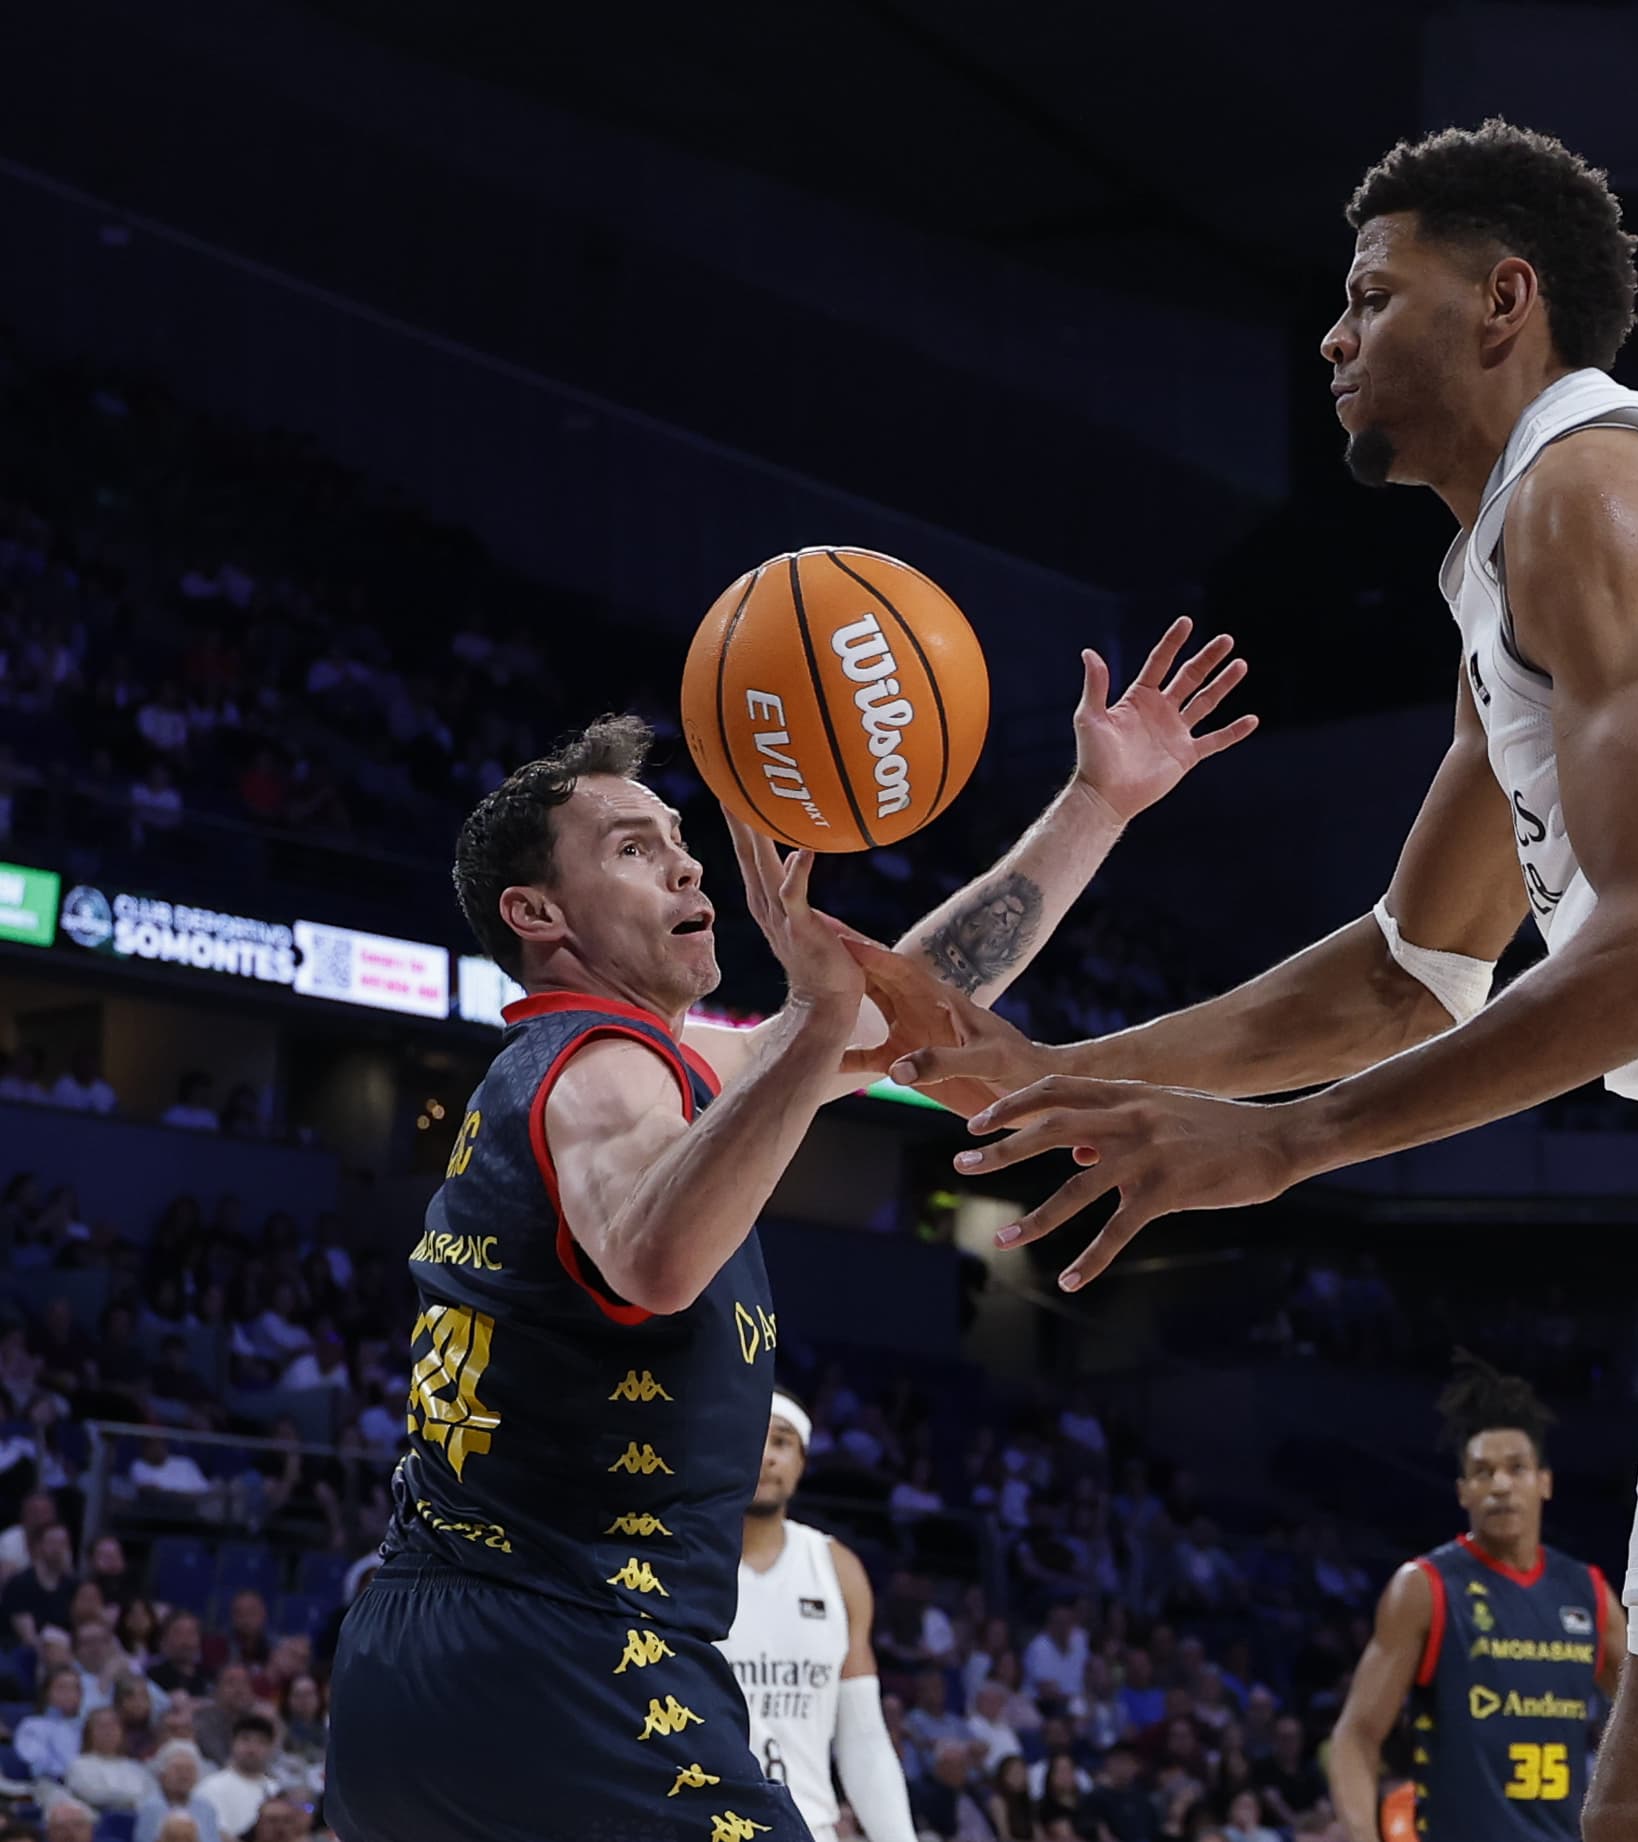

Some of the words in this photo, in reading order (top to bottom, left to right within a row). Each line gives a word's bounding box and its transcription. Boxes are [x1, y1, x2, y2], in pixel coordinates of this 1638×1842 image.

[830, 612, 914, 818] Wilson
[801, 800, 831, 829] NXT
[114, 919, 295, 984] SOMONTES
[1504, 1742, 1571, 1800] 35
